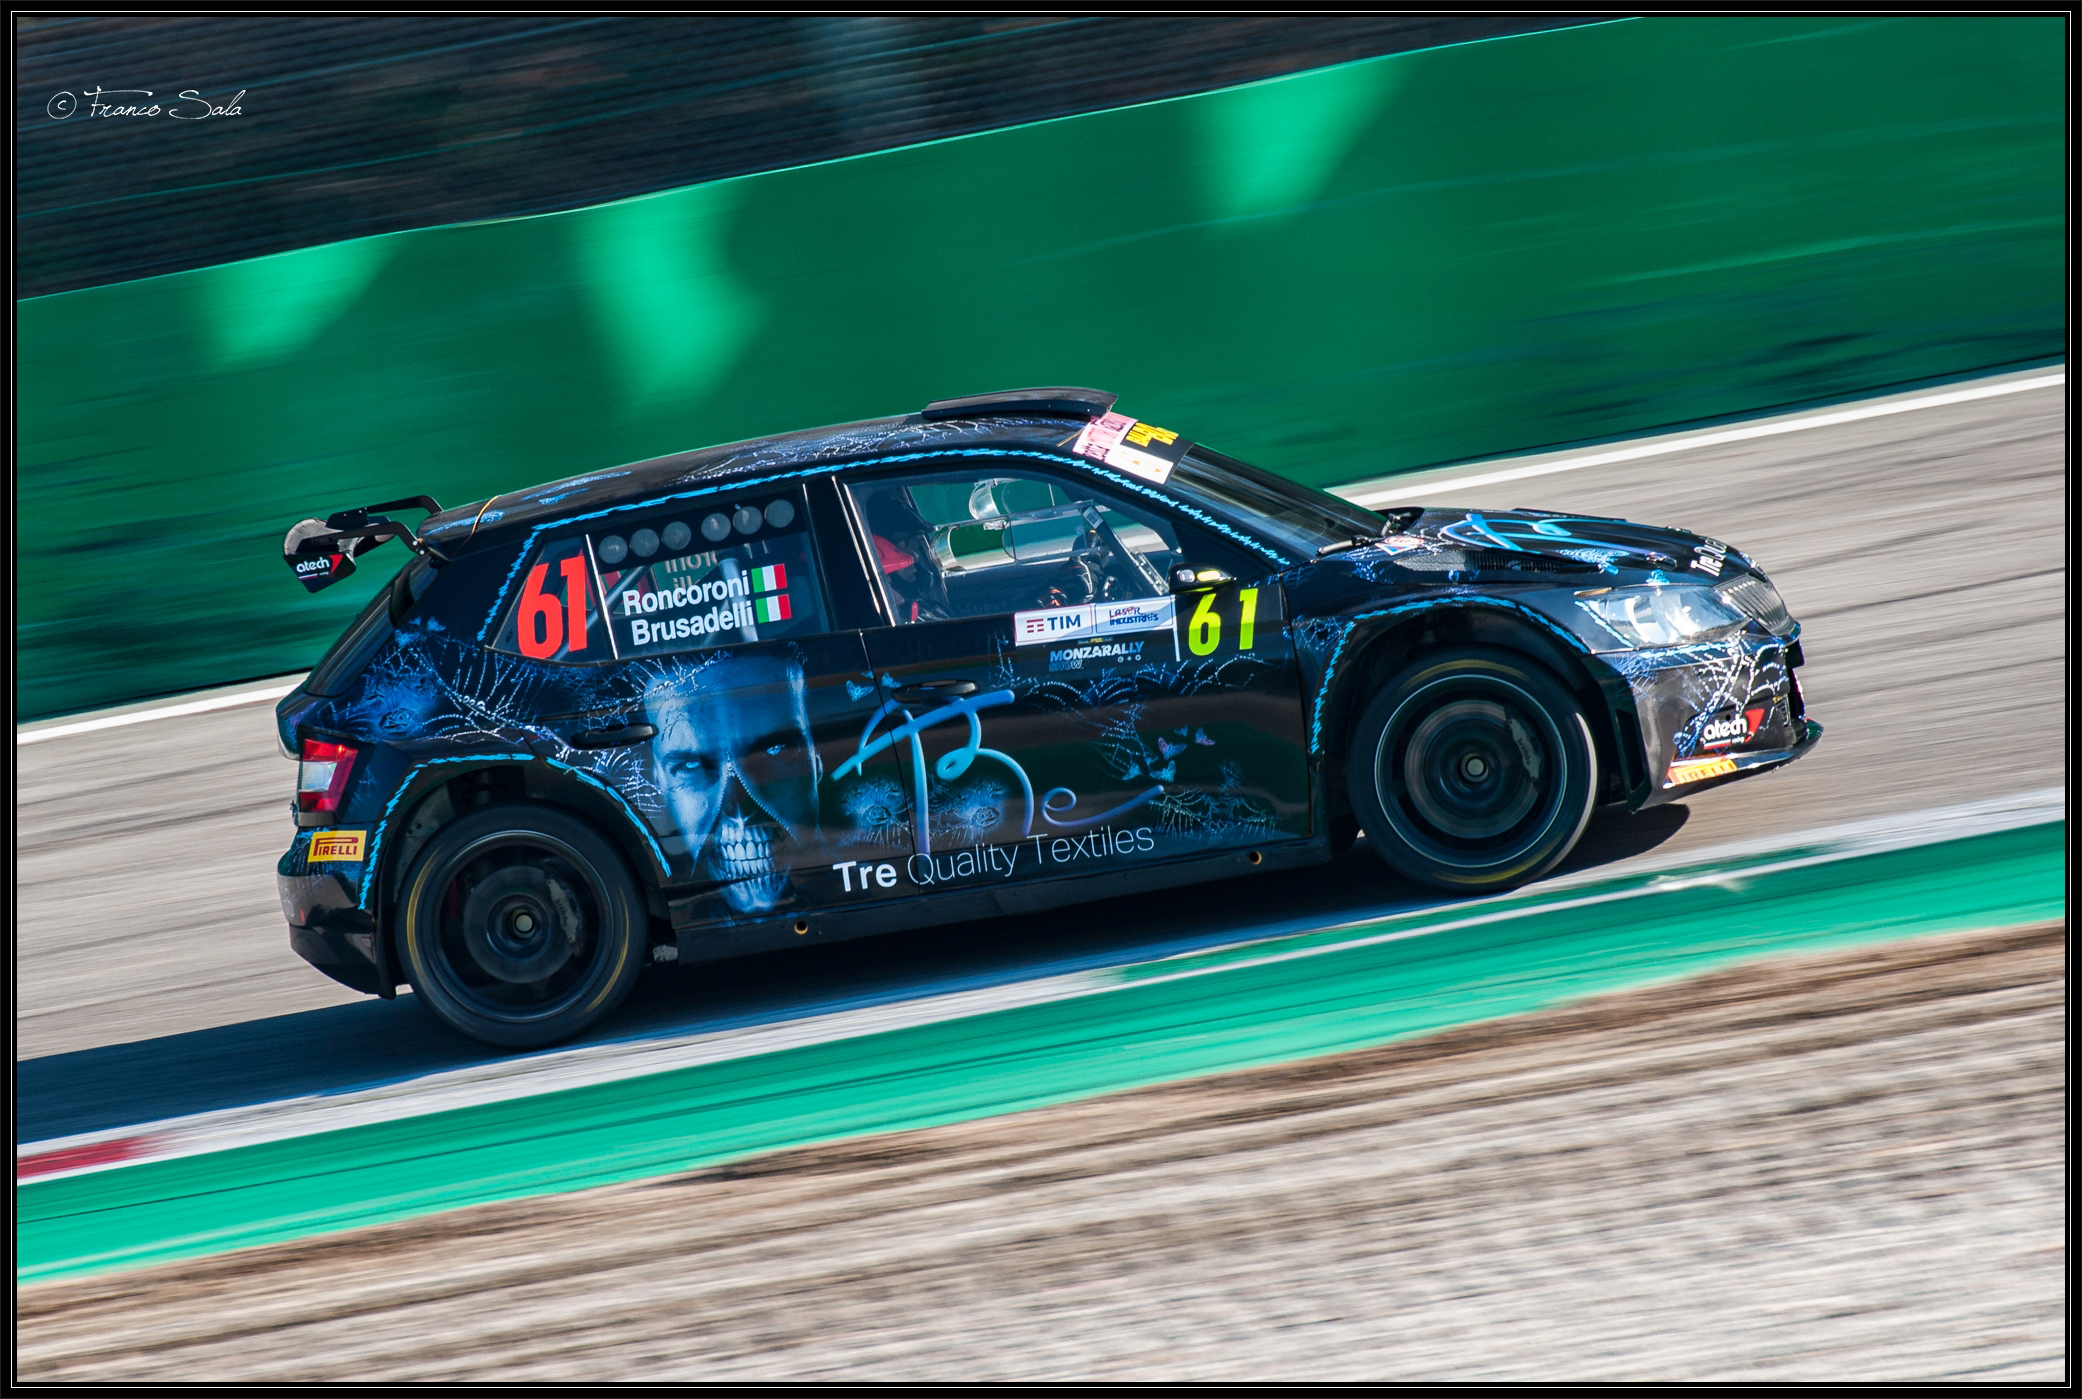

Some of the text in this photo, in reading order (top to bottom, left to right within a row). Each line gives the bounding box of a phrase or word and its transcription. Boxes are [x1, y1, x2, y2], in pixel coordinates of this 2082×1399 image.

[517, 555, 588, 659] 61
[622, 570, 750, 616] Roncoroni
[631, 601, 754, 646] Brusadelli
[1047, 614, 1081, 631] TIM
[1188, 588, 1258, 657] 61
[1050, 641, 1145, 662] MONZARALLY
[312, 837, 359, 856] PIRELLI
[833, 826, 1155, 892] Tre Quality Textiles
